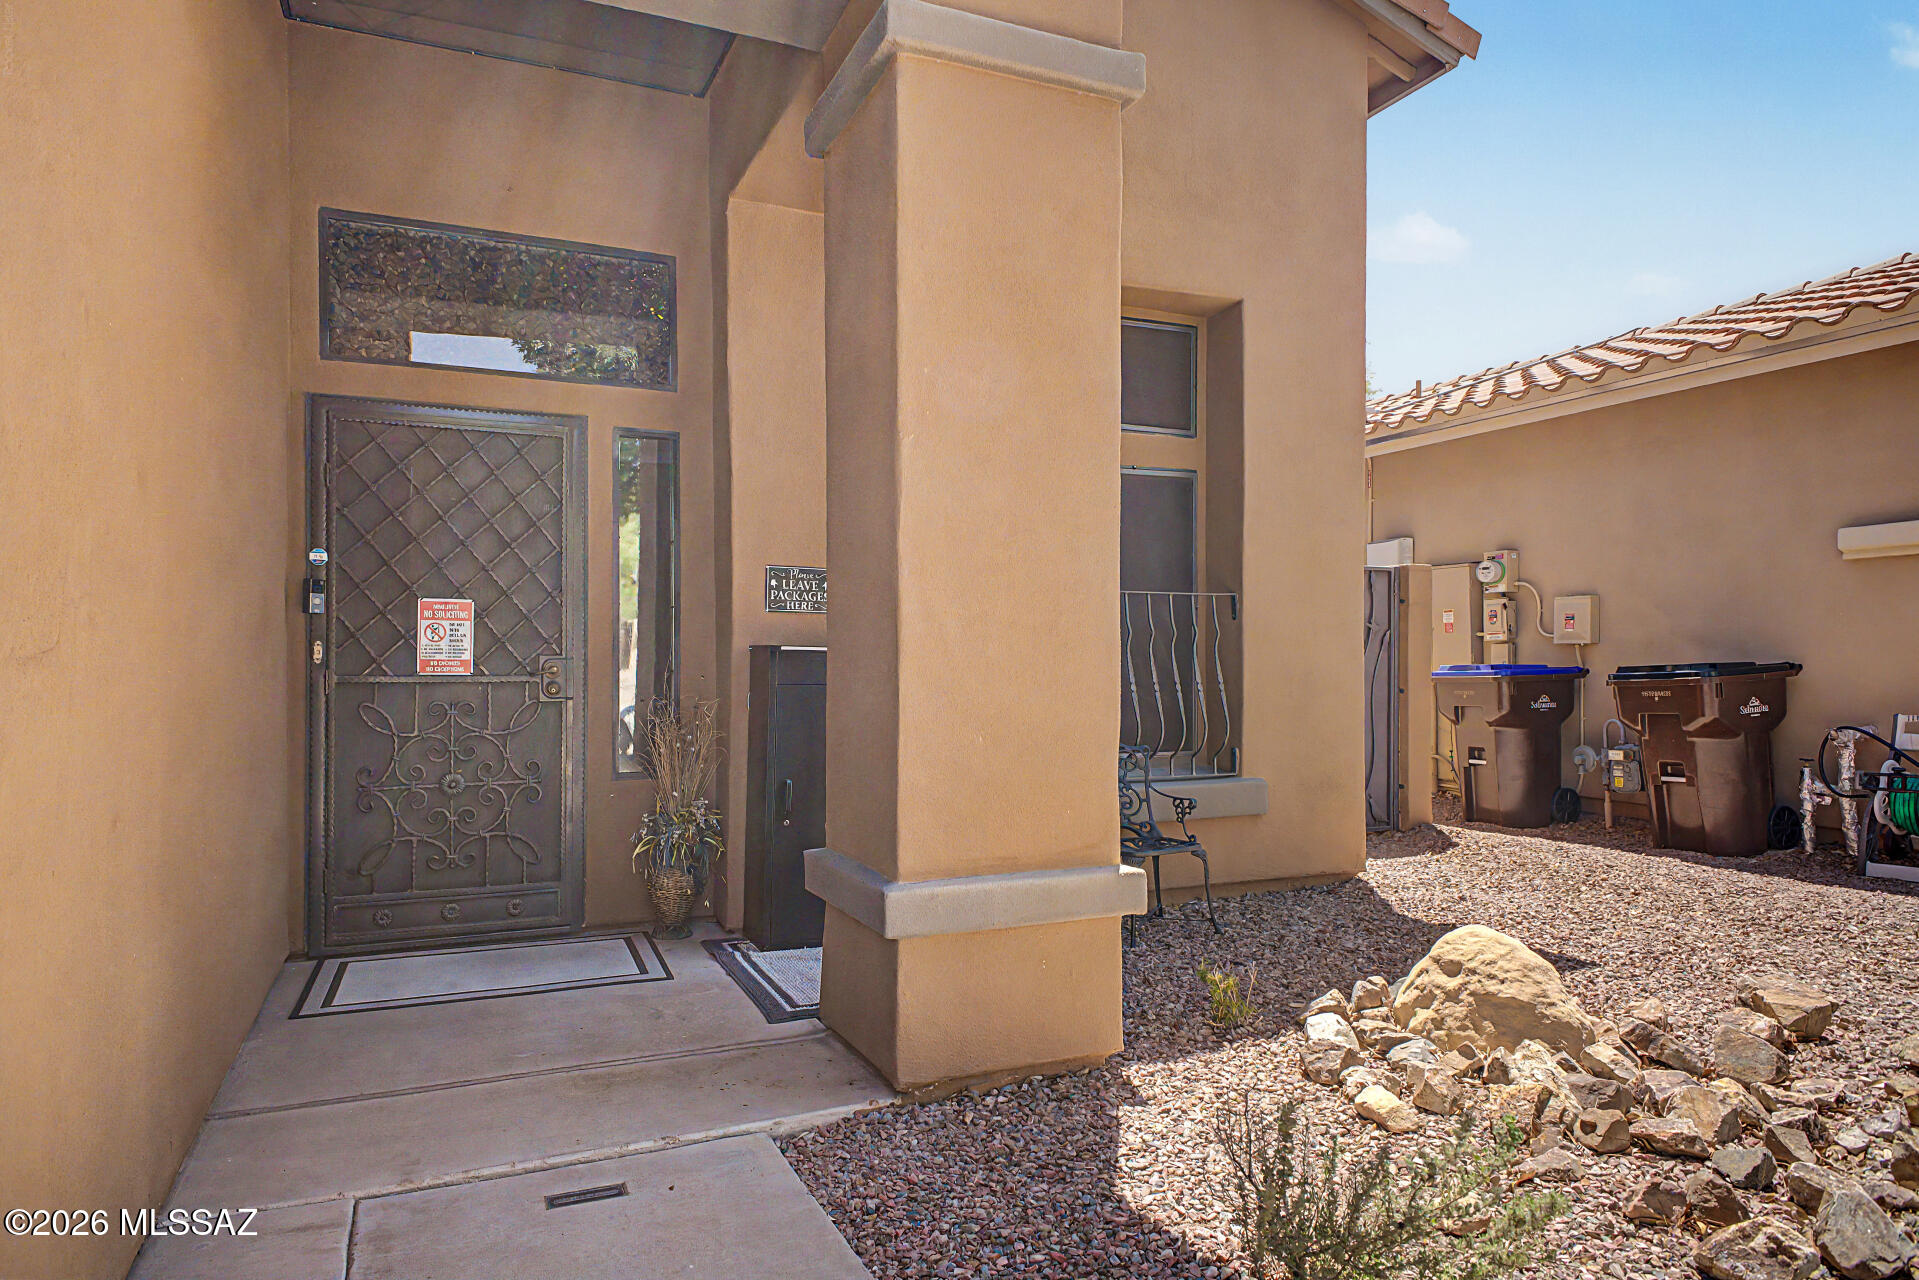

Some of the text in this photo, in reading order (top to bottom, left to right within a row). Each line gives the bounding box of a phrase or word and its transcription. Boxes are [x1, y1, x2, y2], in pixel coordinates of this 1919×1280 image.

[782, 579, 819, 591] LEAVE
[786, 601, 814, 610] HERE
[423, 610, 469, 619] NO SOLICITING
